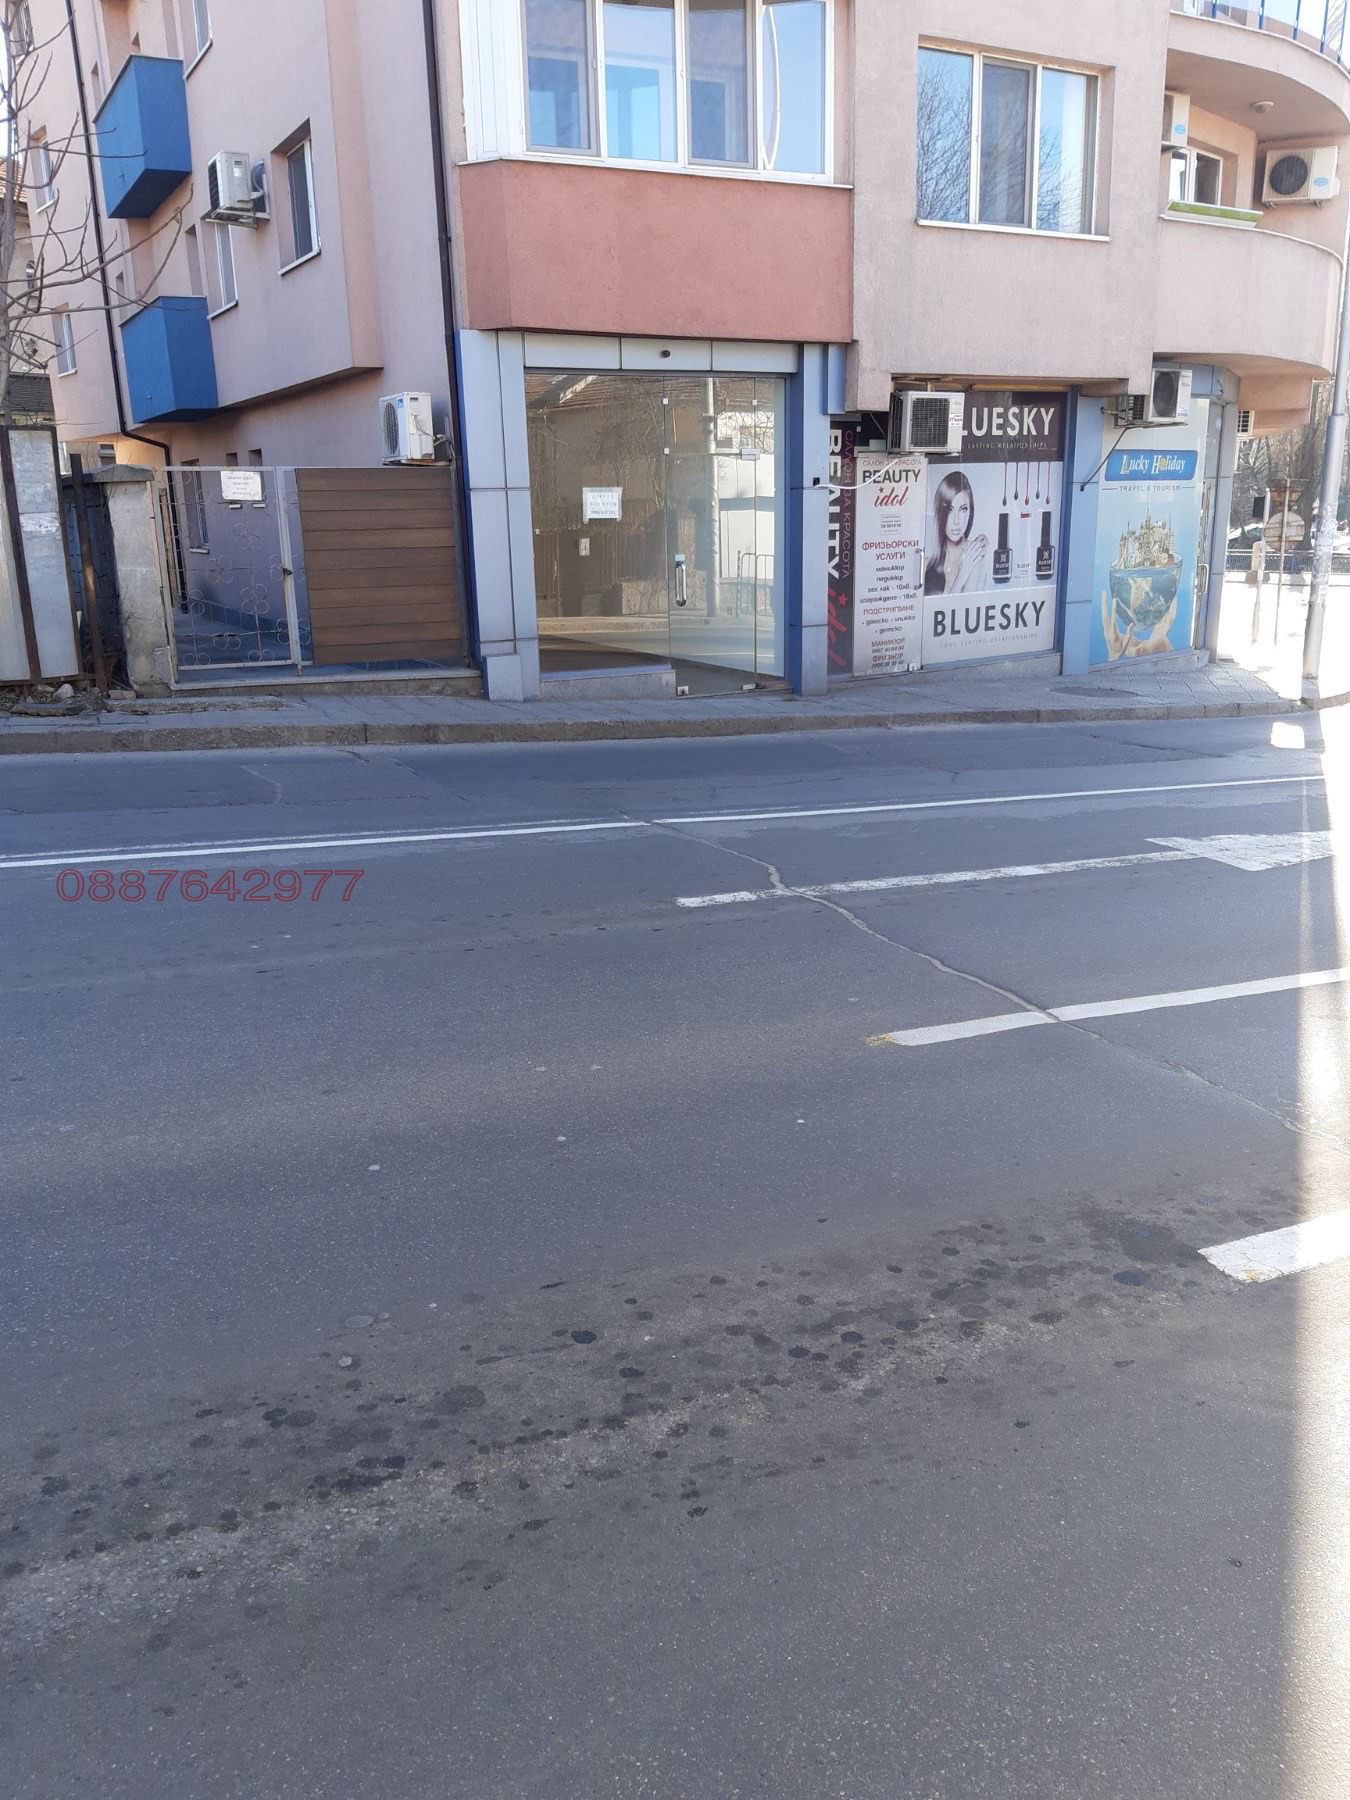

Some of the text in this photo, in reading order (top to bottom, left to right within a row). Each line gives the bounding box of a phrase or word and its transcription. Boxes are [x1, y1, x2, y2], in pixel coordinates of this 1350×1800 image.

[961, 406, 1055, 437] UESKY
[967, 441, 1048, 449] LASTING RELATIONSHIPS
[862, 459, 884, 467] САЛОН
[1120, 454, 1186, 475] Lucky Holiday
[862, 469, 922, 484] BEAUTY
[874, 486, 909, 508] idol
[842, 430, 854, 579] САЛОН ЗА КРАСОТА
[862, 540, 920, 551] ФРИЗЬОРСКИ
[875, 551, 906, 561] УСЛУГИ
[876, 564, 904, 573] маникюр
[863, 604, 915, 616] ПОДСТРИГВАНЕ
[866, 617, 889, 627] дамско
[933, 600, 1046, 638] BLUESKY
[879, 625, 902, 635] детско
[871, 637, 906, 648] МАНИКЮР
[960, 638, 987, 647] LASTING
[990, 633, 1039, 643] RELATIONSHIPS
[872, 652, 904, 663] ФРИЗЬОР
